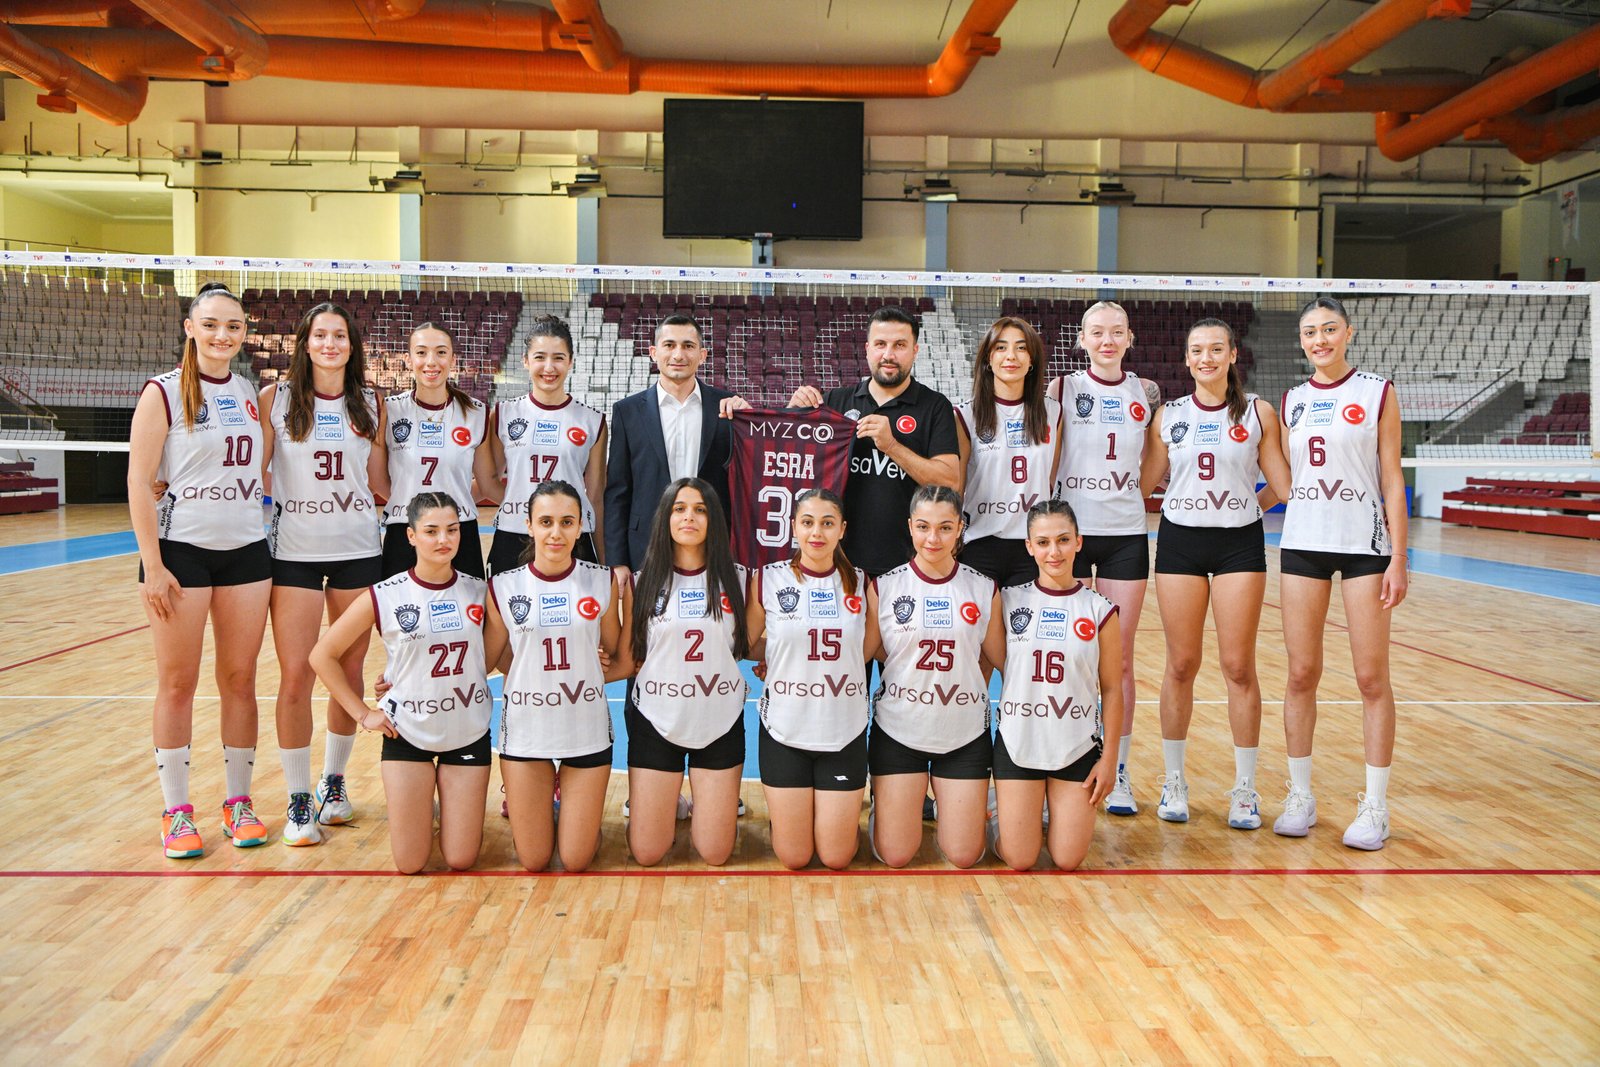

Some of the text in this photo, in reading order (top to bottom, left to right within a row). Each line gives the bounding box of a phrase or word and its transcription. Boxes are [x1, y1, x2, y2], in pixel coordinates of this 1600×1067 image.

[217, 397, 236, 406] beko
[1102, 398, 1120, 406] beko
[317, 414, 340, 422] beko
[421, 423, 442, 431] beko
[537, 422, 558, 430] beko
[223, 435, 252, 466] 10
[1105, 433, 1117, 460] 1
[1308, 436, 1326, 467] 6
[314, 451, 344, 480] 31
[421, 457, 438, 485] 7
[530, 455, 559, 483] 17
[763, 451, 815, 479] ESRA
[850, 449, 907, 481] saVev
[1011, 455, 1028, 484] 8
[1198, 452, 1215, 480] 9
[183, 479, 263, 501] arsaVe
[1066, 471, 1139, 491] arsaVev
[285, 491, 372, 514] arsaVev
[977, 493, 1040, 514] arsaV
[1169, 490, 1248, 511] arsaVev
[431, 602, 455, 611] beko
[542, 595, 567, 604] beko
[811, 591, 834, 599] beko
[926, 599, 950, 607] beko
[1042, 610, 1066, 620] beko
[542, 637, 571, 671] 11
[684, 629, 704, 661] 2
[807, 628, 842, 661] 15
[916, 639, 955, 672] 25
[429, 641, 469, 678] 27
[1032, 650, 1065, 684] 16
[510, 680, 604, 707] arsaVev
[645, 673, 740, 698] arsaVev
[773, 674, 863, 698] arsaVev
[888, 683, 980, 706] arsaVev
[402, 682, 489, 715] arsaVev
[1003, 695, 1093, 720] arsaVev
